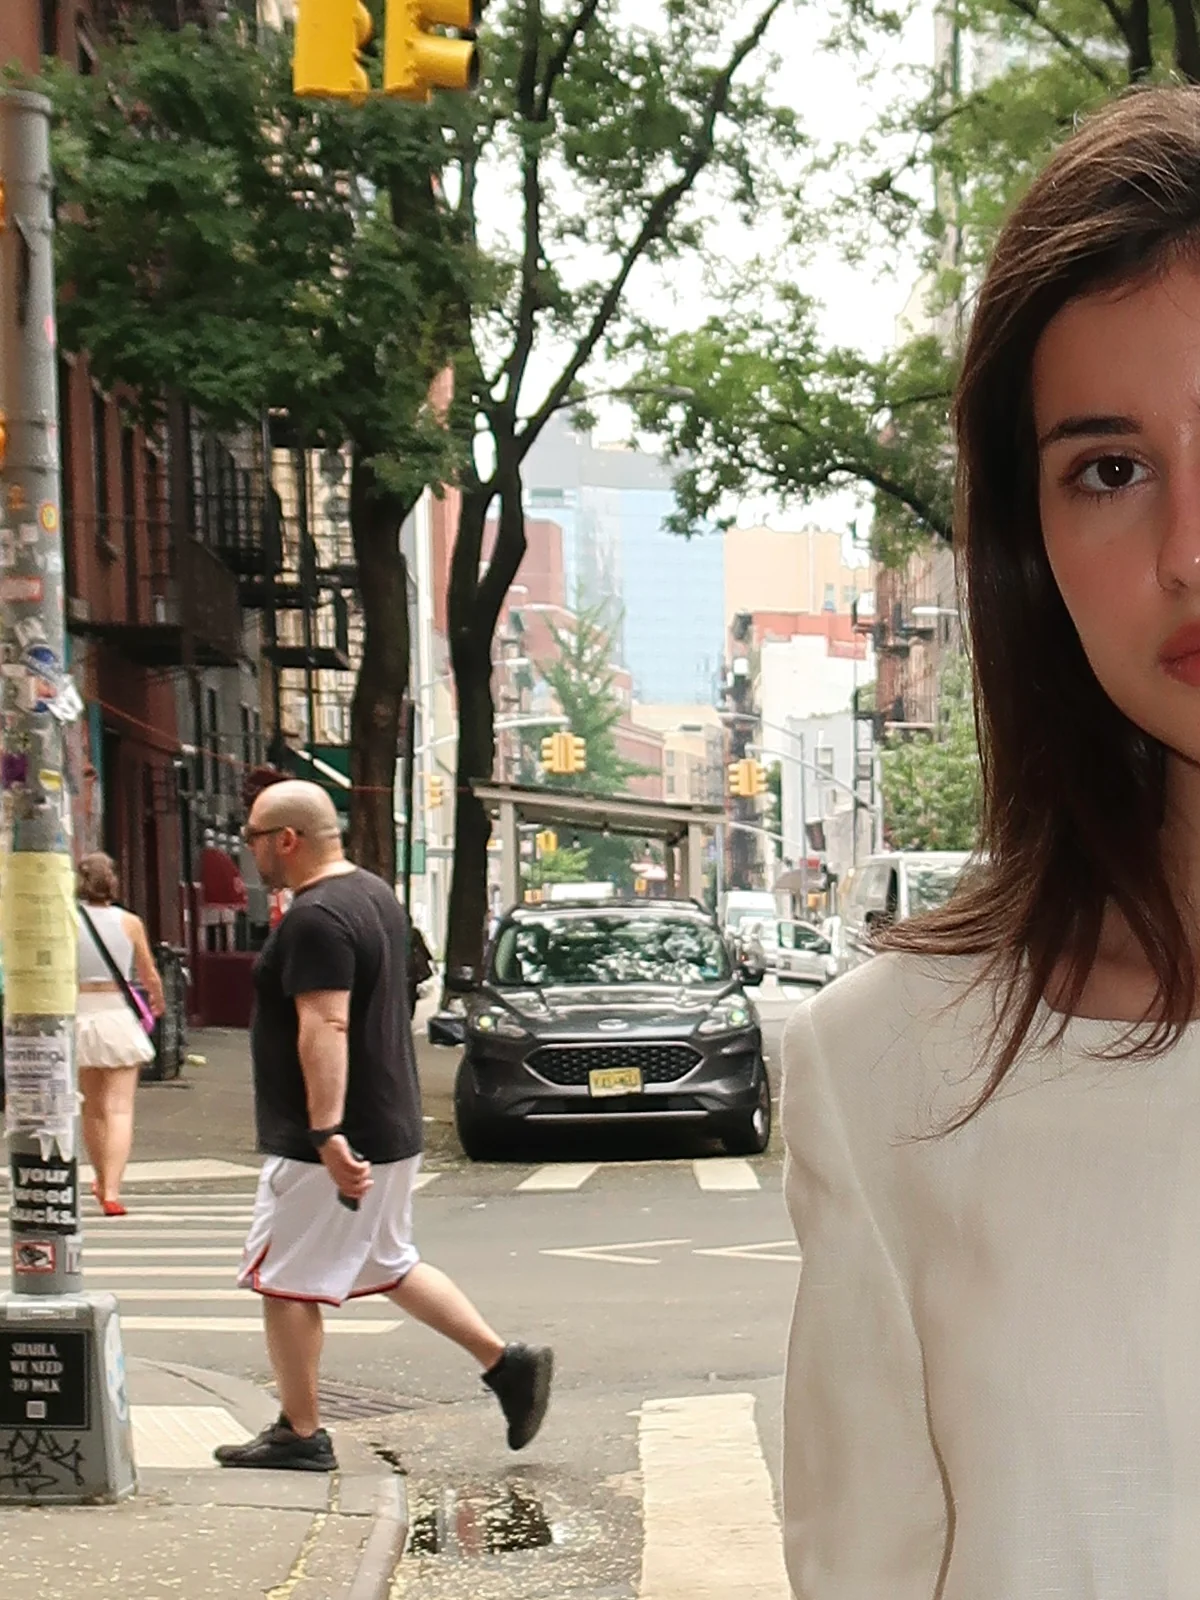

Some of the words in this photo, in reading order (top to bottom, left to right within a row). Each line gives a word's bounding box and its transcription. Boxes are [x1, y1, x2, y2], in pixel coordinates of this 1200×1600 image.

[18, 1167, 70, 1186] your
[15, 1186, 74, 1204] weed
[10, 1360, 28, 1375] WE
[31, 1360, 64, 1375] NEED
[12, 1378, 29, 1393] TO
